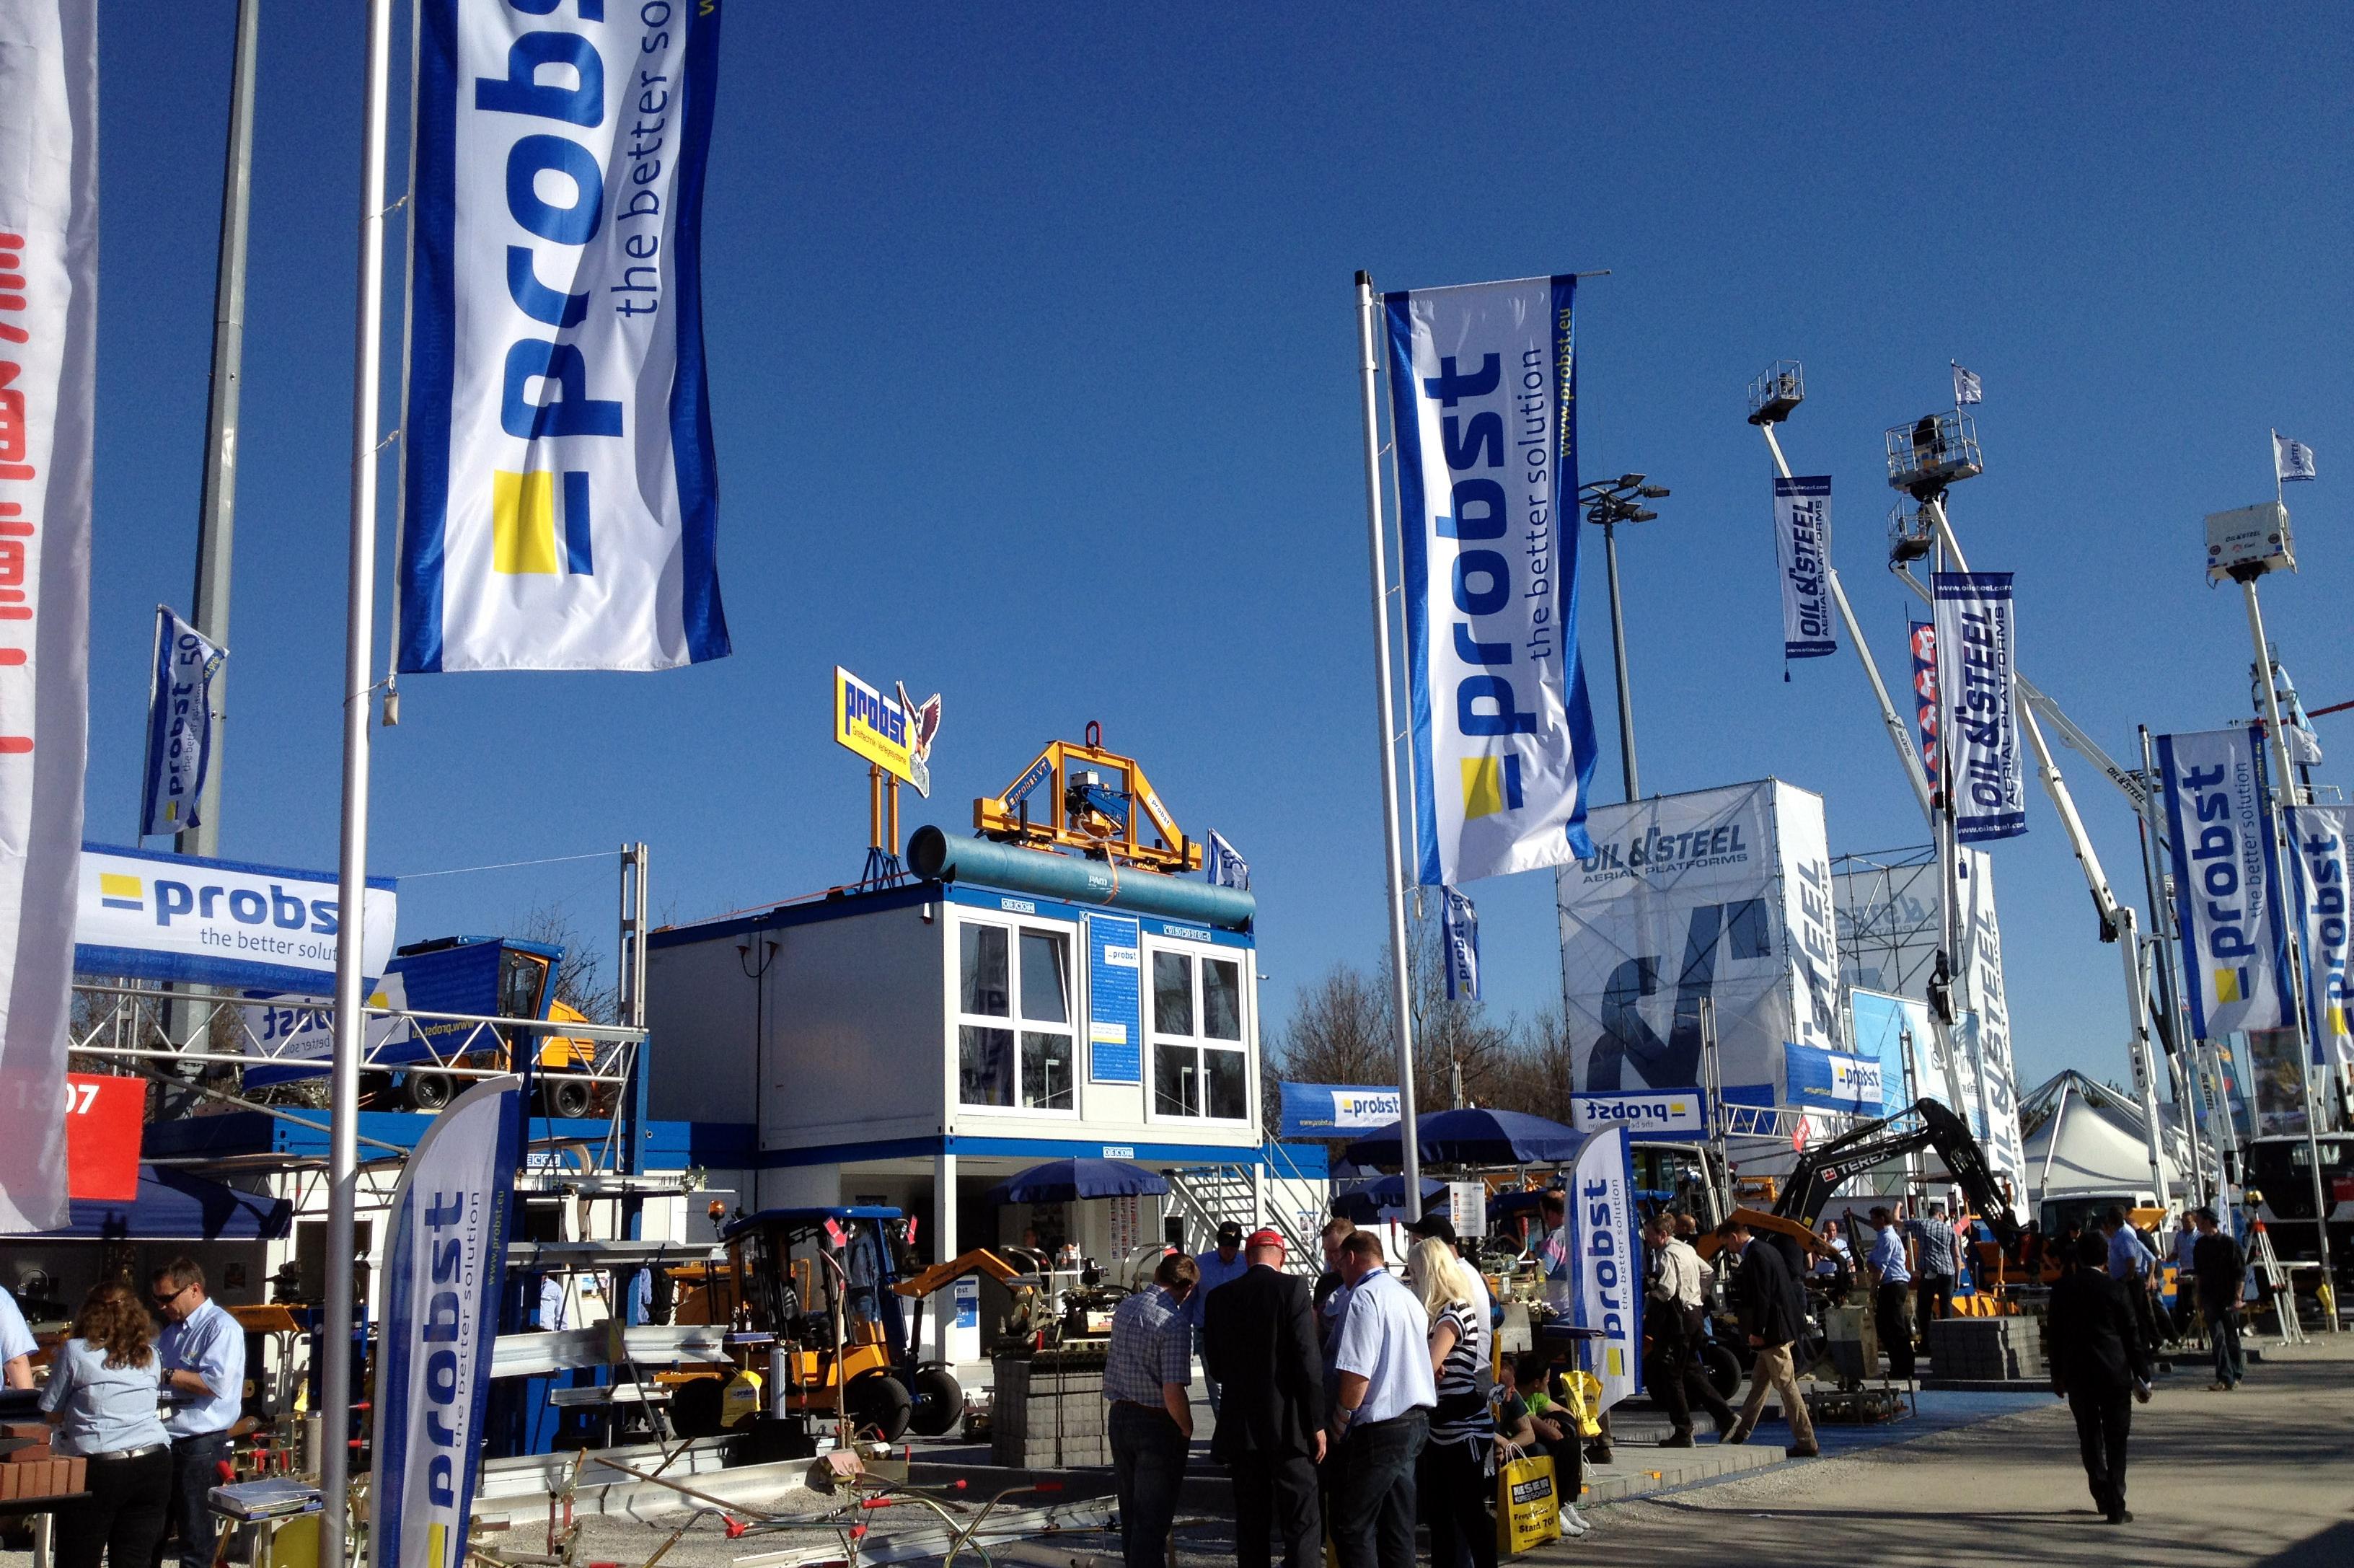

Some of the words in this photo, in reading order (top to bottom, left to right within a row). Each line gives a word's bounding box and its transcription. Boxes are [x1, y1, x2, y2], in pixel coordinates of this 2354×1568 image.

[618, 70, 667, 221] better
[611, 234, 658, 318] the
[1558, 307, 1572, 457] www.probst.eu
[1521, 348, 1548, 483] solution
[1424, 352, 1538, 736] probst
[1525, 493, 1551, 596] better
[1815, 499, 1825, 583] PLATFORMS
[1528, 608, 1551, 662] the
[1820, 588, 1829, 637] AERIAL
[178, 633, 203, 665] 50
[1995, 606, 2009, 729] PLATFORMS
[169, 682, 194, 796] probst
[845, 679, 907, 749] probst
[1013, 774, 1038, 805] probst
[2002, 735, 2016, 807] AERIAL
[2234, 761, 2255, 829] solution
[1151, 798, 1171, 827] probst
[1582, 869, 1640, 884] AERIAL
[1644, 853, 1748, 875] PLATFORMS
[2182, 763, 2257, 959] probst
[2244, 832, 2262, 886] better
[154, 878, 339, 936] probs
[1002, 899, 1035, 913] OECON
[2251, 890, 2263, 919] the
[2304, 833, 2354, 1000] probst
[200, 928, 232, 947] the
[238, 933, 294, 956] better
[299, 941, 338, 961] solut
[1113, 949, 1137, 961] probst
[1452, 920, 1471, 980] probst
[1354, 1096, 1400, 1118] probst
[1104, 1147, 1133, 1158] OECON
[1837, 1150, 1892, 1175] TEREX
[487, 1189, 505, 1287] www.probst.eu
[1612, 1179, 1623, 1236] solution
[464, 1191, 480, 1301] solution
[1583, 1179, 1626, 1341] probst
[1618, 1239, 1627, 1284] better
[423, 1191, 464, 1510] probst
[458, 1311, 470, 1396] better
[455, 1404, 464, 1448] the
